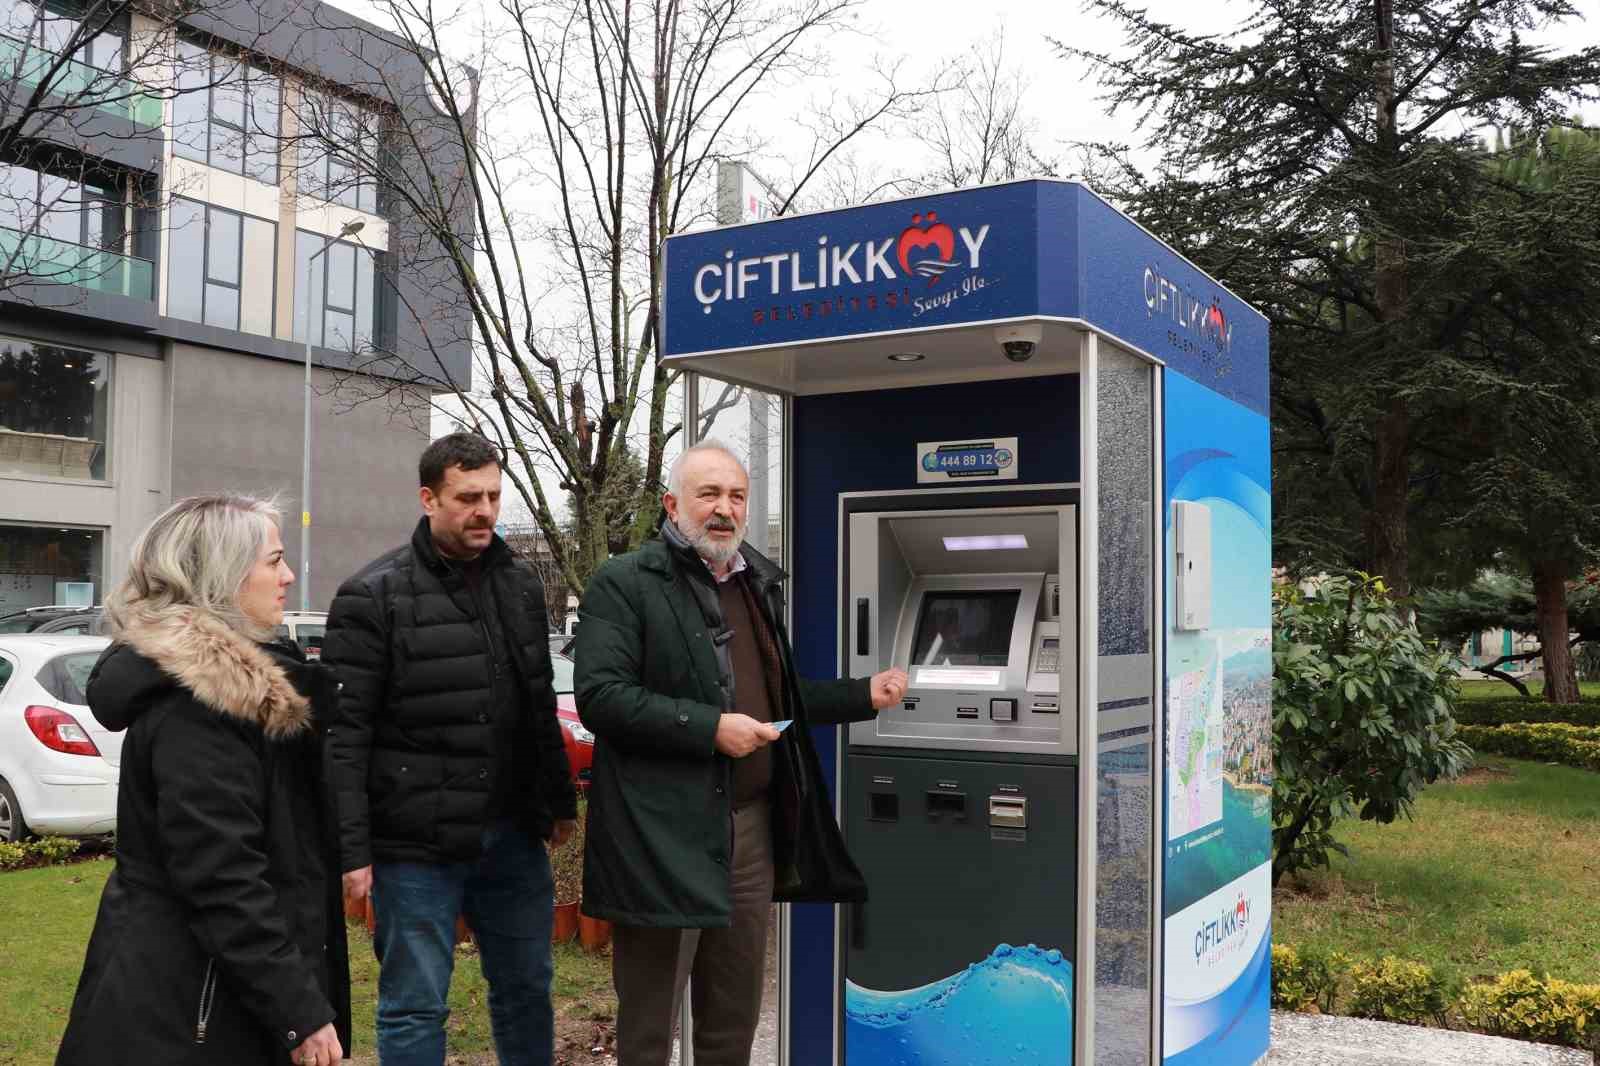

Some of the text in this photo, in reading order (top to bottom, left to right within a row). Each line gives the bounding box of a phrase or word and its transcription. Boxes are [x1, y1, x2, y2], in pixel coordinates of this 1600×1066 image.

[694, 211, 990, 314] ÇİFTLİKKÖY
[941, 456, 960, 467] 444
[962, 455, 976, 466] 89
[980, 454, 993, 465] 12
